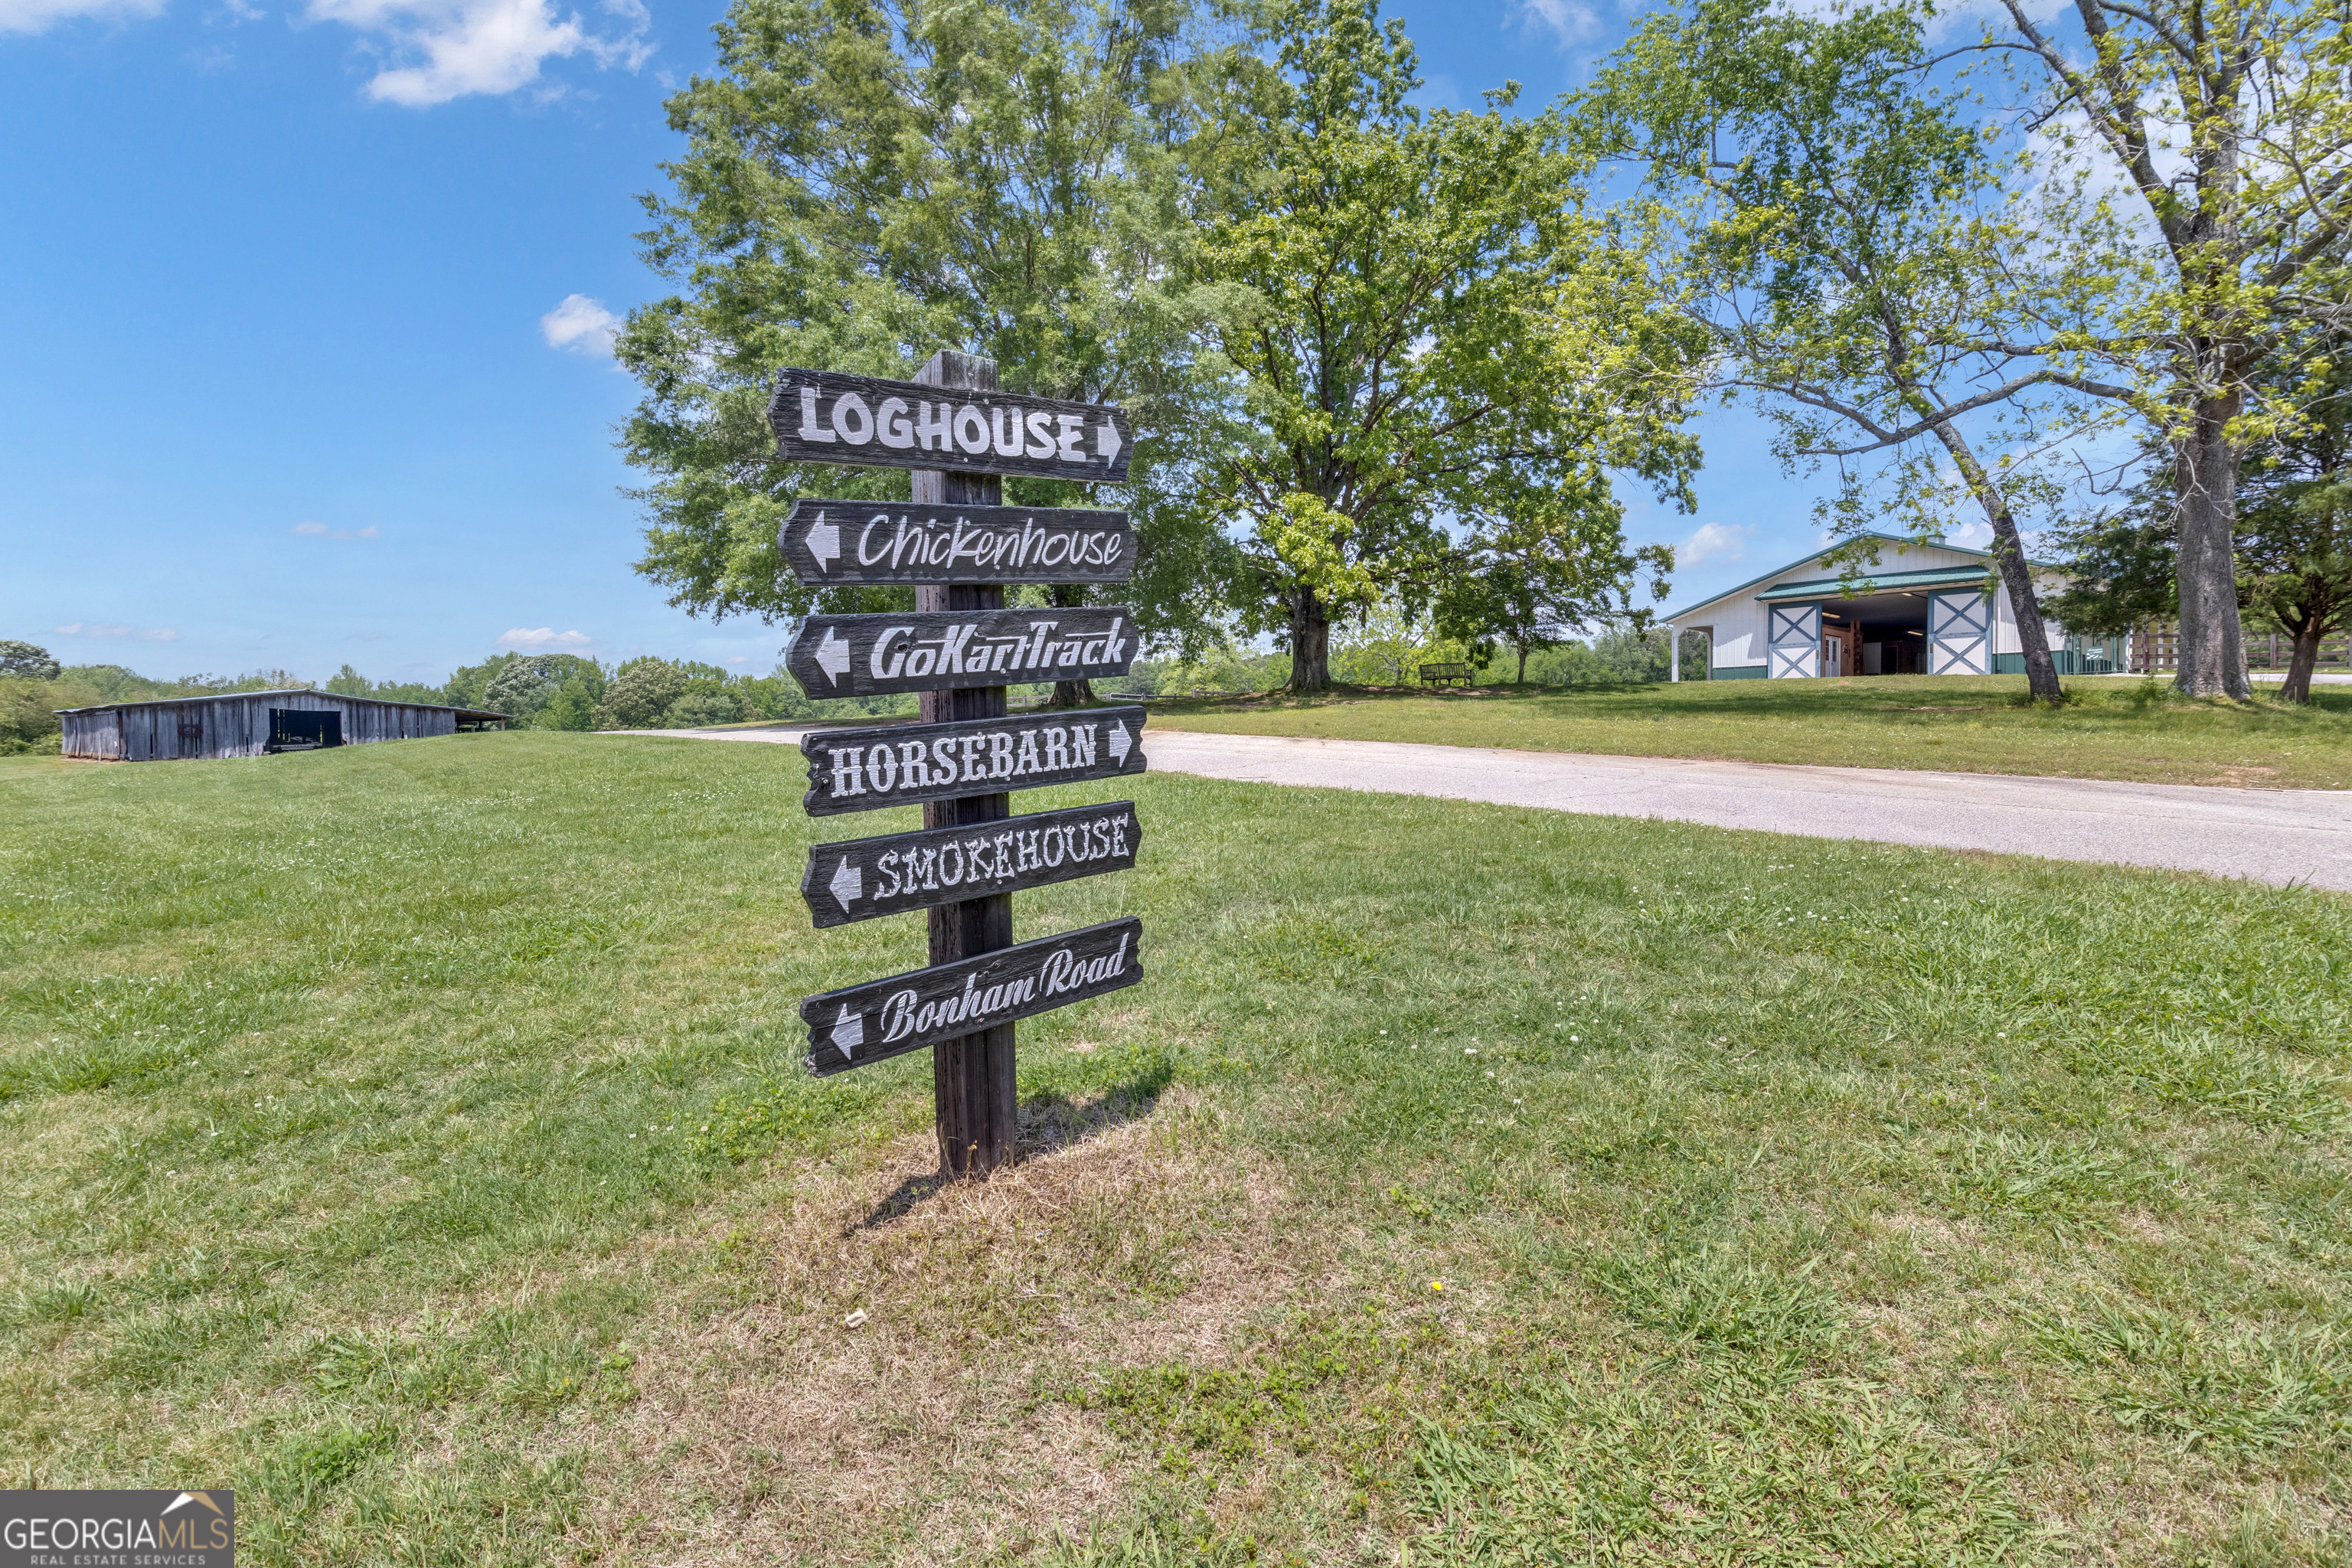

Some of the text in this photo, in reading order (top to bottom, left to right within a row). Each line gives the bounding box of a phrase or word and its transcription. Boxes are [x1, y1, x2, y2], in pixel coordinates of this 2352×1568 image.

[798, 387, 1086, 462] LOGHOUSE
[857, 514, 1122, 570] Chickenhouse
[828, 724, 1098, 798] HORSEBARN
[874, 813, 1129, 900] SMOKEHOUSE
[880, 933, 1129, 1044] Bonham Road
